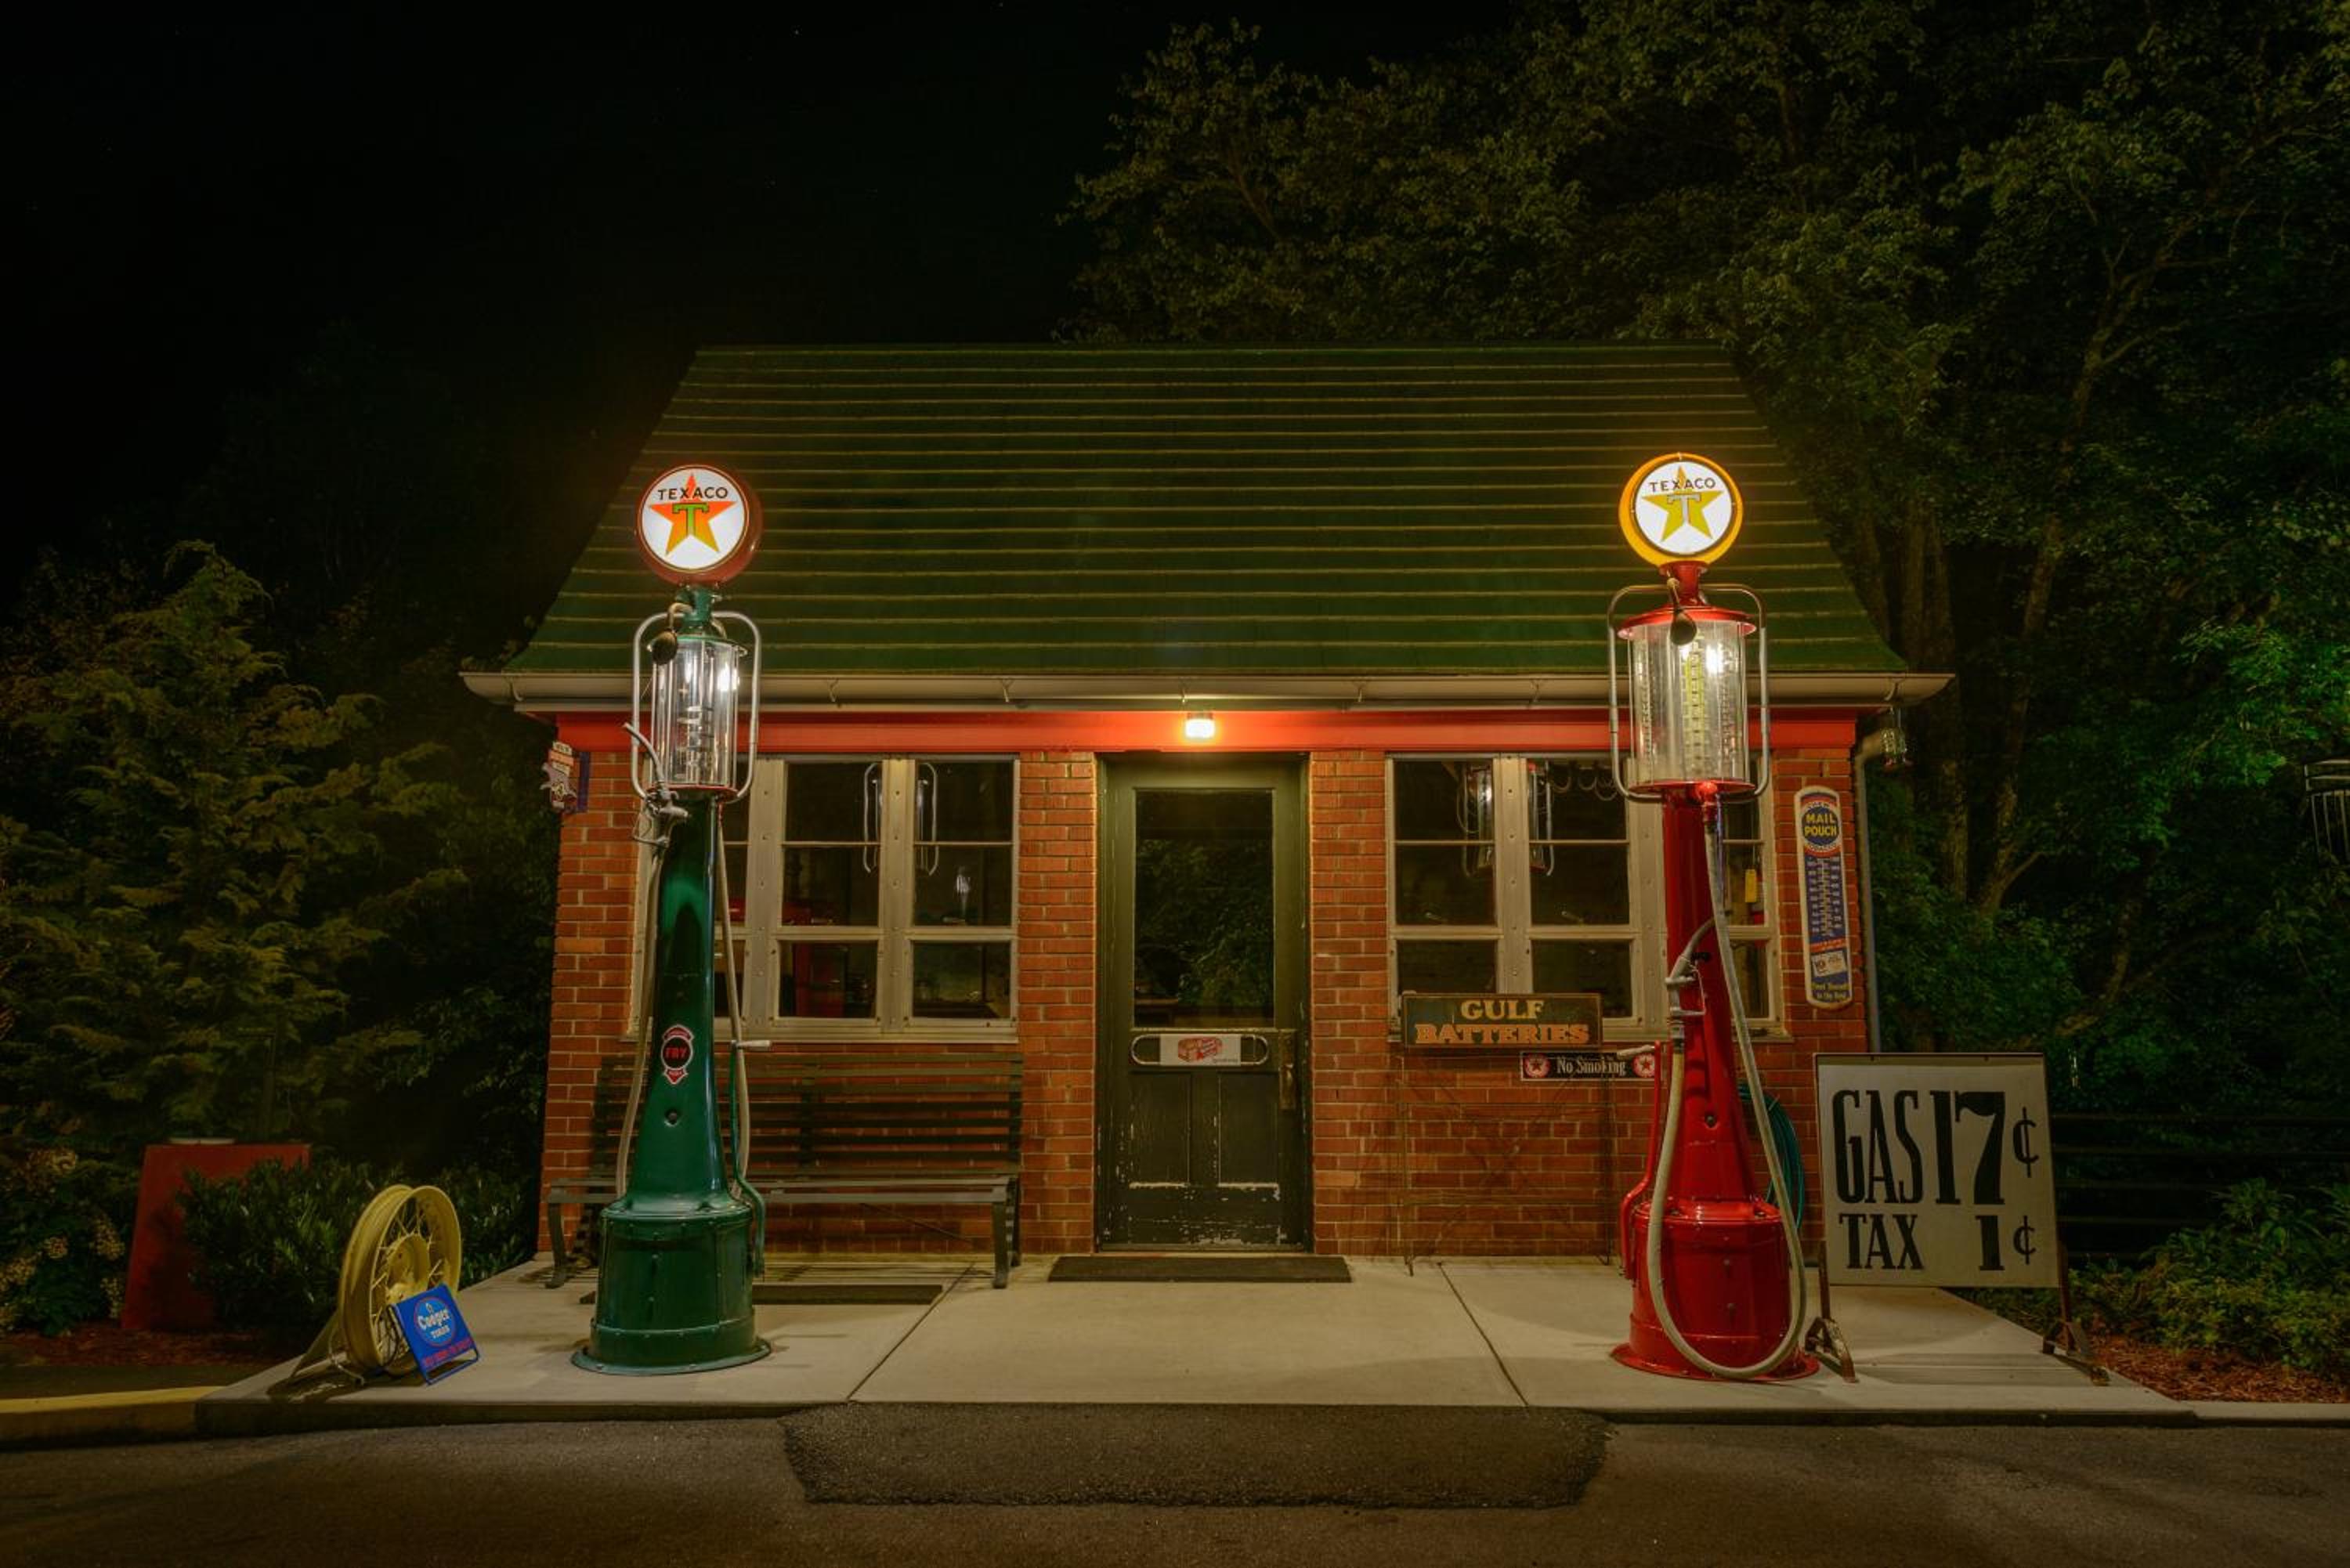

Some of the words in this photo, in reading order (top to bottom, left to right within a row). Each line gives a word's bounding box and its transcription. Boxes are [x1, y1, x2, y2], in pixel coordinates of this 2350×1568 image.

[657, 486, 728, 500] TEXACO
[1649, 477, 1716, 493] TEXACO
[1806, 813, 1836, 824] MAIL
[1804, 825, 1837, 837] POUCH
[1460, 999, 1546, 1021] GULF
[1414, 1023, 1589, 1044] BATTERIES
[1556, 1057, 1572, 1074] No
[1575, 1057, 1627, 1076] Smoking
[1832, 1089, 1924, 1204] GAS
[1838, 1213, 1925, 1270] TAX
